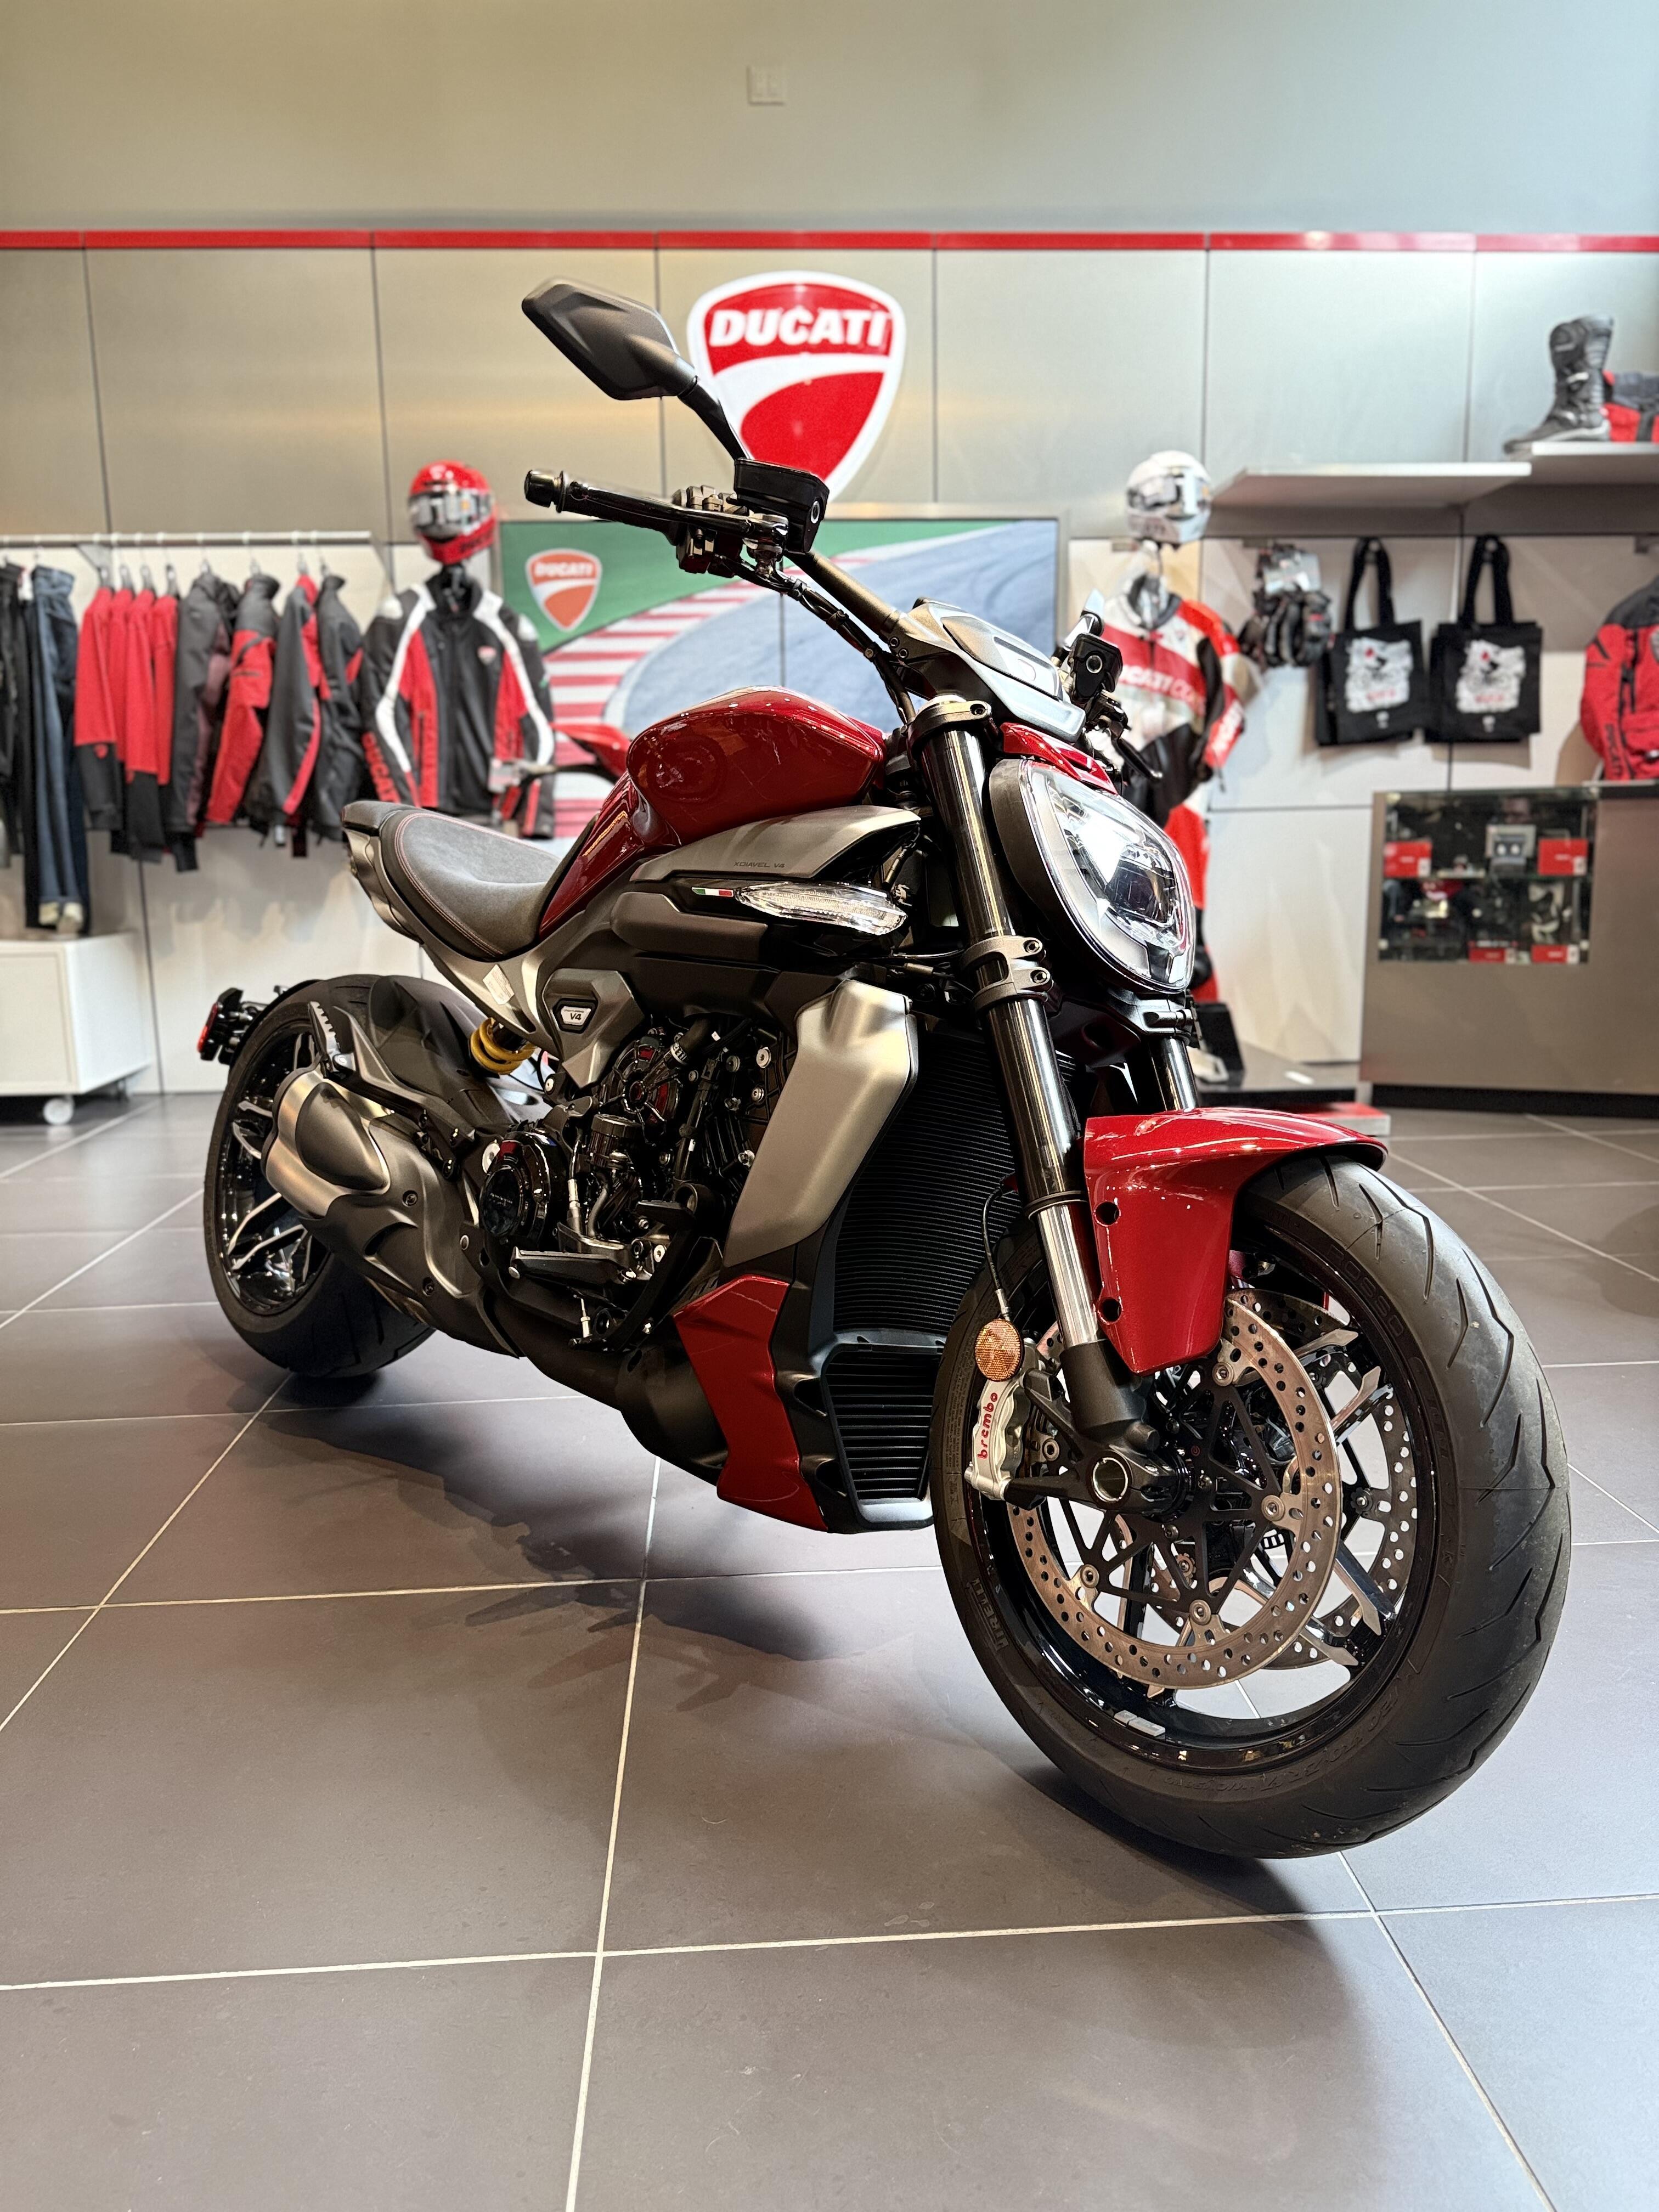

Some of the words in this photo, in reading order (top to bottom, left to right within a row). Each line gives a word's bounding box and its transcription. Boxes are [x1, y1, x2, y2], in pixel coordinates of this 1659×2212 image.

[709, 308, 889, 347] DUCATI
[534, 561, 594, 577] DUCATI
[361, 731, 400, 804] DUCAT
[570, 1012, 582, 1020] V4
[1329, 1244, 1404, 1338] ROSSO
[977, 1391, 998, 1460] brembo
[966, 1578, 1009, 1651] PIRELLI
